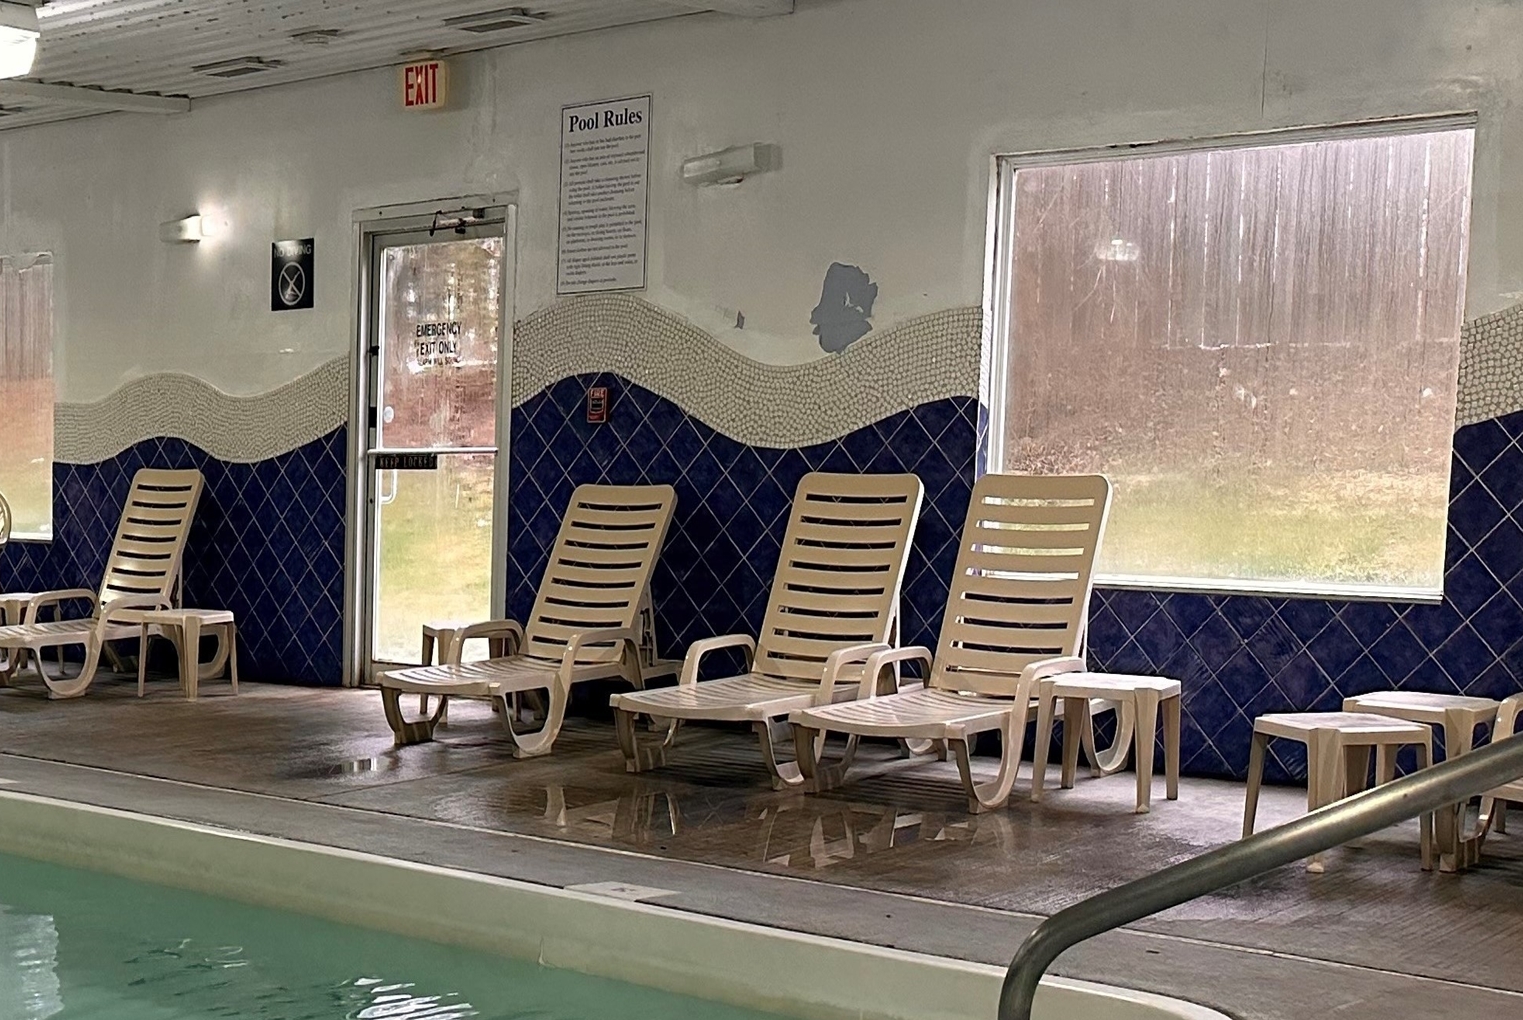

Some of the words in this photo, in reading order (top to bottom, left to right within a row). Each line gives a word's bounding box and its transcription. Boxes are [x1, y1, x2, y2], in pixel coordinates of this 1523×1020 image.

[405, 63, 438, 106] EXIT
[569, 112, 599, 132] Pool
[604, 108, 642, 127] Rules
[416, 321, 462, 337] EMERGENCY
[420, 341, 436, 355] EXIT
[438, 340, 457, 354] ONLY
[379, 456, 399, 468] KEEP
[403, 456, 434, 468] LOCKED
